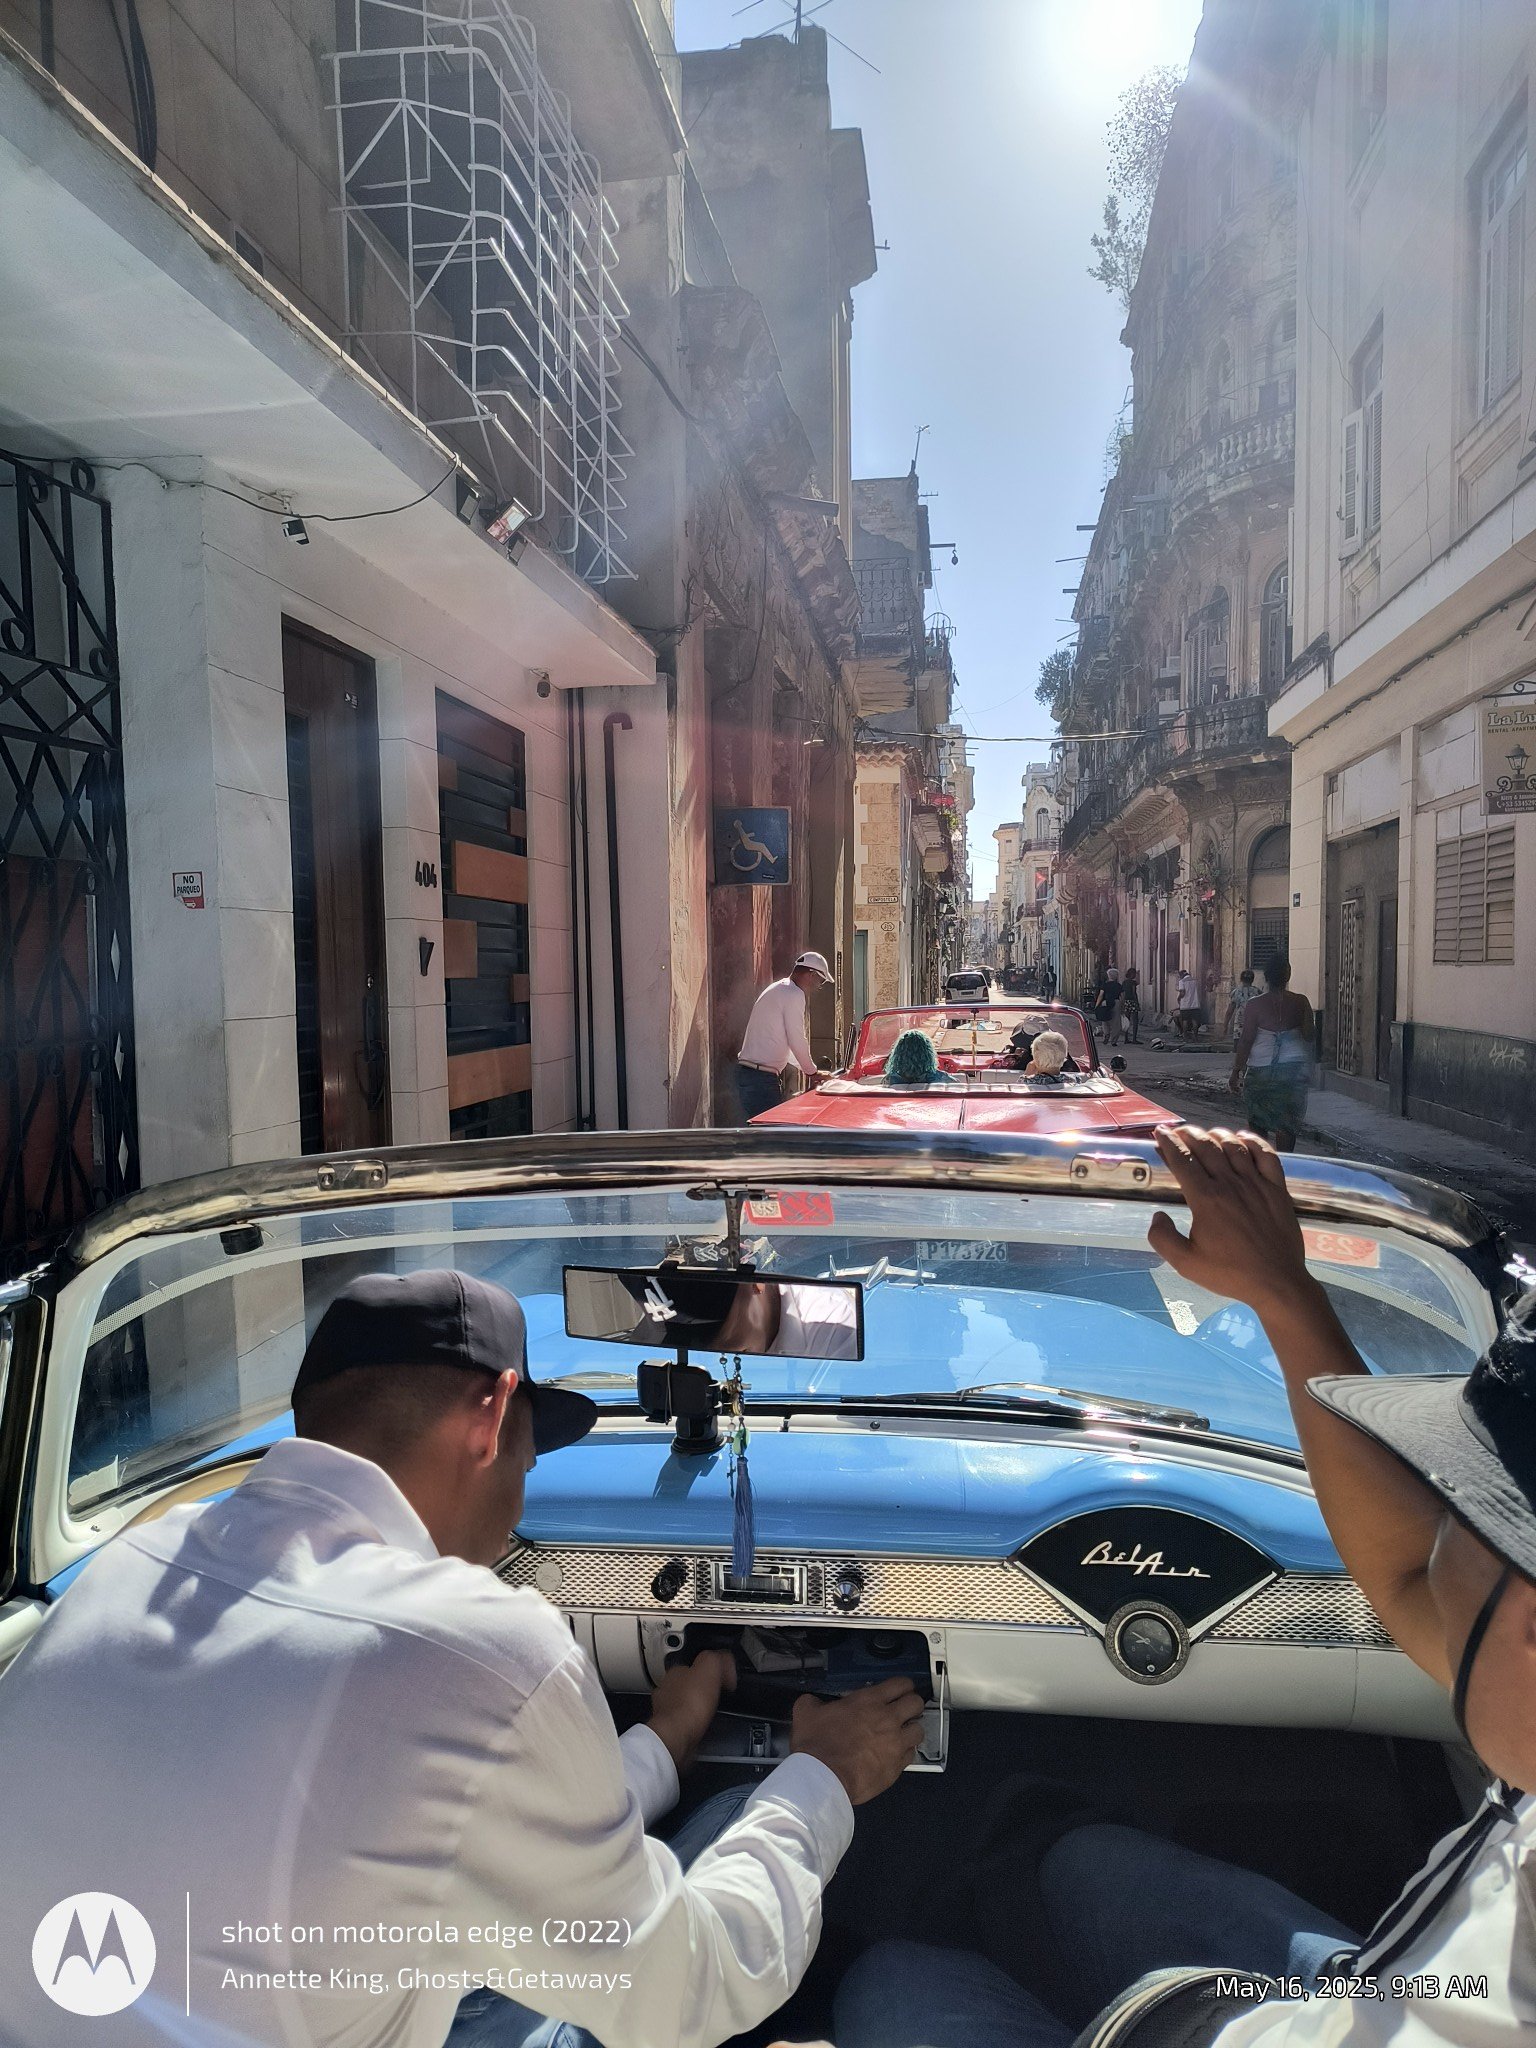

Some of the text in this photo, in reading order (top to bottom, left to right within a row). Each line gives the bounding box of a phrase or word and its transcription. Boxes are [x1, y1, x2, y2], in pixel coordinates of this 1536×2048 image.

[1487, 712, 1513, 726] La
[183, 875, 195, 884] NO
[415, 861, 437, 888] 404
[176, 885, 201, 895] PARQUEO
